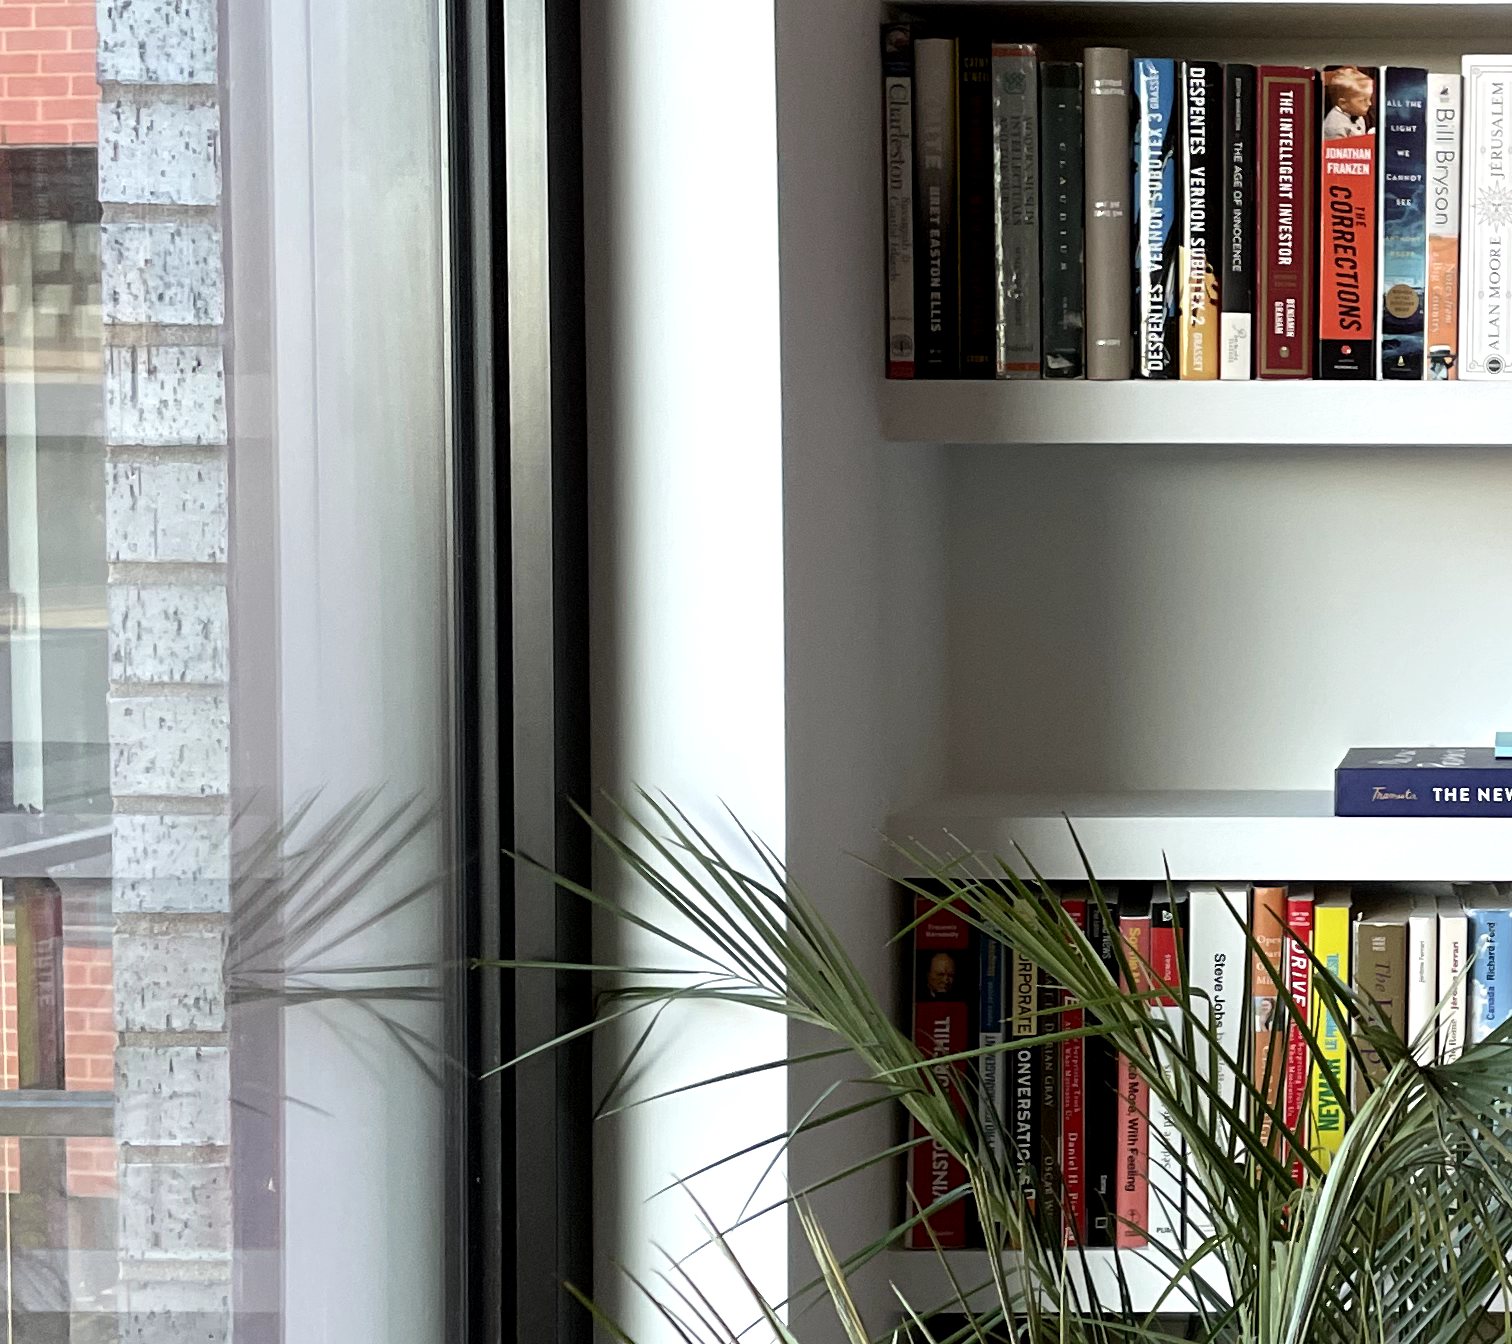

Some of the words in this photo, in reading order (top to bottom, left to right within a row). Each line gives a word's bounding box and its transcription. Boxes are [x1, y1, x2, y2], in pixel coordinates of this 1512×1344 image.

[1190, 67, 1206, 154] DESPENTES
[1280, 90, 1294, 114] THE
[1435, 108, 1456, 141] Bill
[1489, 82, 1505, 180] JÉRUSALEM
[1233, 142, 1243, 162] THE
[1279, 117, 1294, 197] INTELLIGENT
[1326, 148, 1372, 159] JONATHAN
[1327, 162, 1370, 175] FRANZEN
[1233, 165, 1243, 187] AGE
[1428, 150, 1455, 225] Bryson
[1191, 166, 1206, 233] VERNON
[1233, 190, 1243, 205] OF
[1355, 206, 1367, 227] THE
[1232, 209, 1242, 271] INNOCENCE
[1279, 203, 1293, 265] INVESTOR
[1189, 237, 1205, 310] SUBUTEX
[1329, 185, 1362, 331] CORRECTIONS
[1489, 236, 1501, 299] MOORE
[1190, 315, 1204, 325] 2
[1488, 304, 1500, 350] ALAN
[1432, 787, 1470, 802] THE
[1213, 953, 1226, 992] Steve
[1213, 995, 1226, 1027] Jobs
